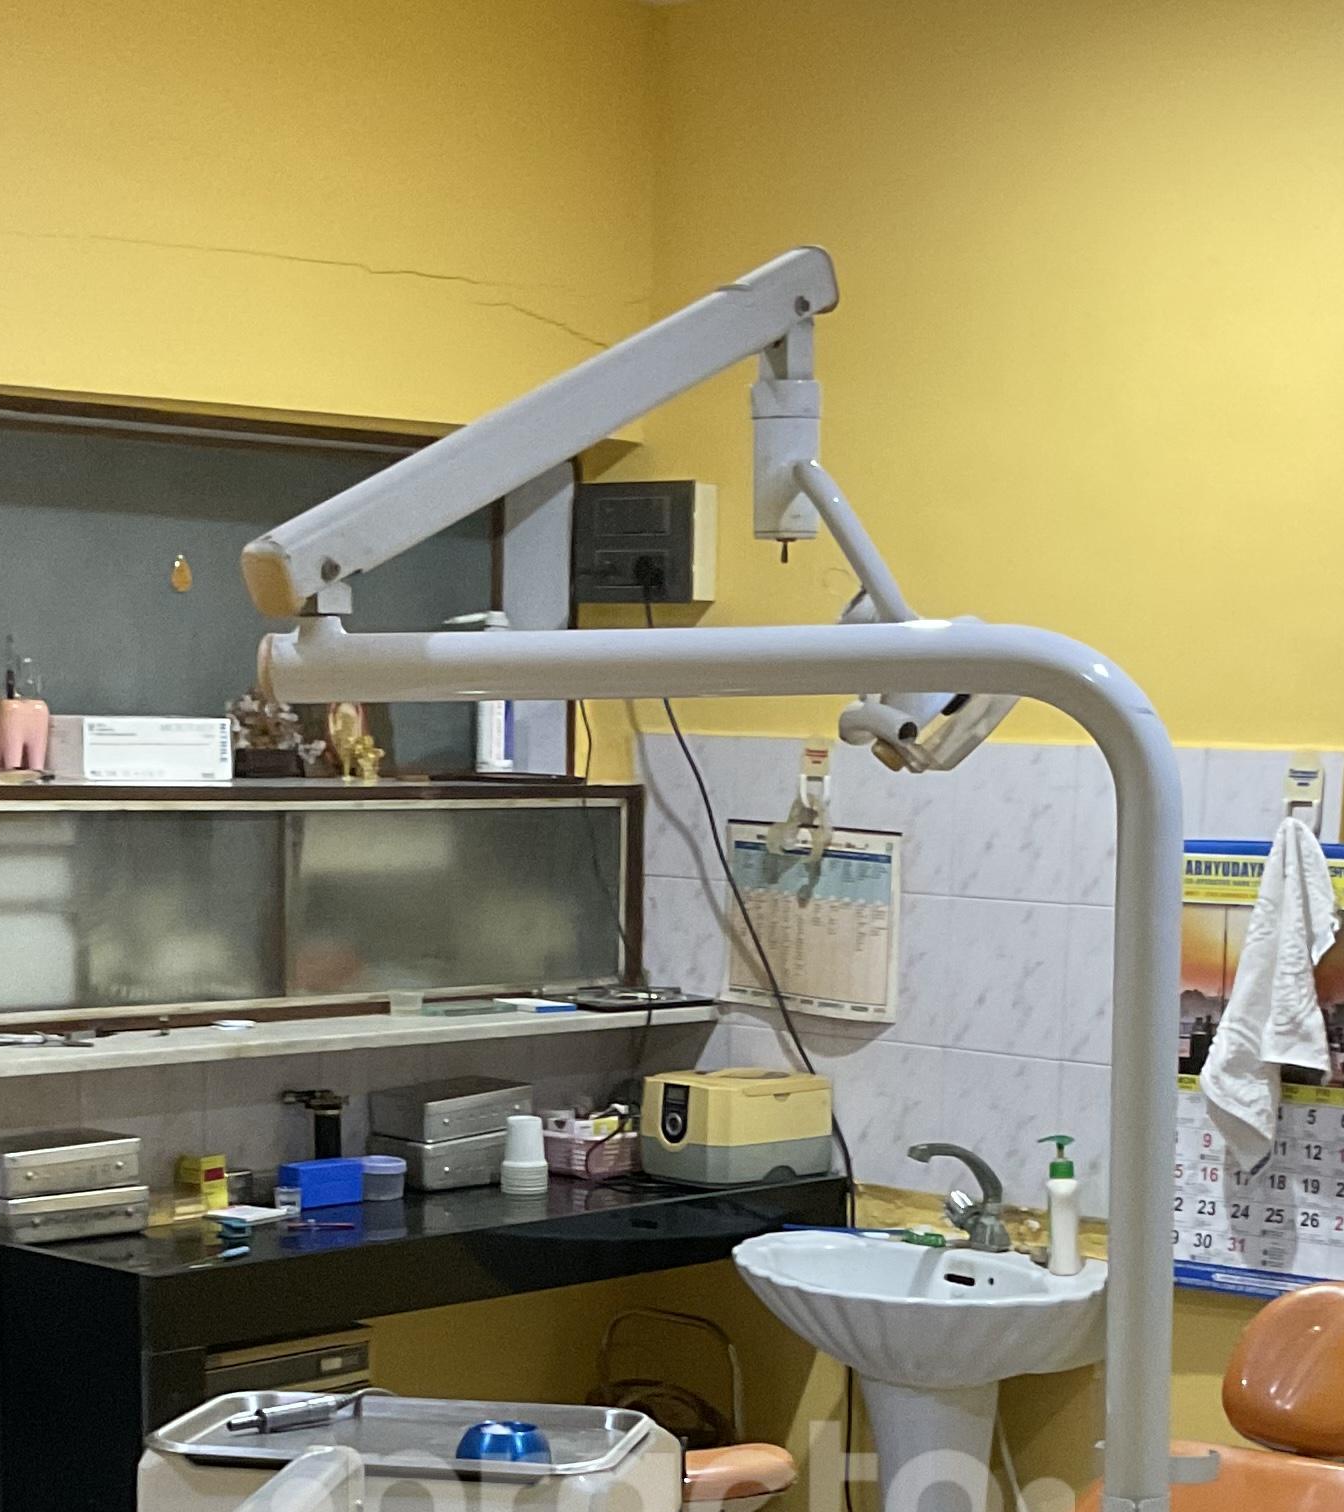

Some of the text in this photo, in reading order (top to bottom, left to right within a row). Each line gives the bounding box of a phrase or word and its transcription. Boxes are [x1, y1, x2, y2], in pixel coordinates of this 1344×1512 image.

[1307, 1109, 1317, 1125] 5
[1202, 1133, 1212, 1148] 9
[1305, 1144, 1322, 1160] 12
[1200, 1167, 1219, 1182] 16
[1269, 1174, 1287, 1190] 18
[1302, 1178, 1320, 1194] 19
[1197, 1200, 1216, 1216] 23
[1230, 1203, 1250, 1220] 24
[1264, 1207, 1285, 1224] 25
[1300, 1211, 1320, 1228] 26
[1193, 1233, 1212, 1249] 30
[1227, 1237, 1246, 1253] 31
